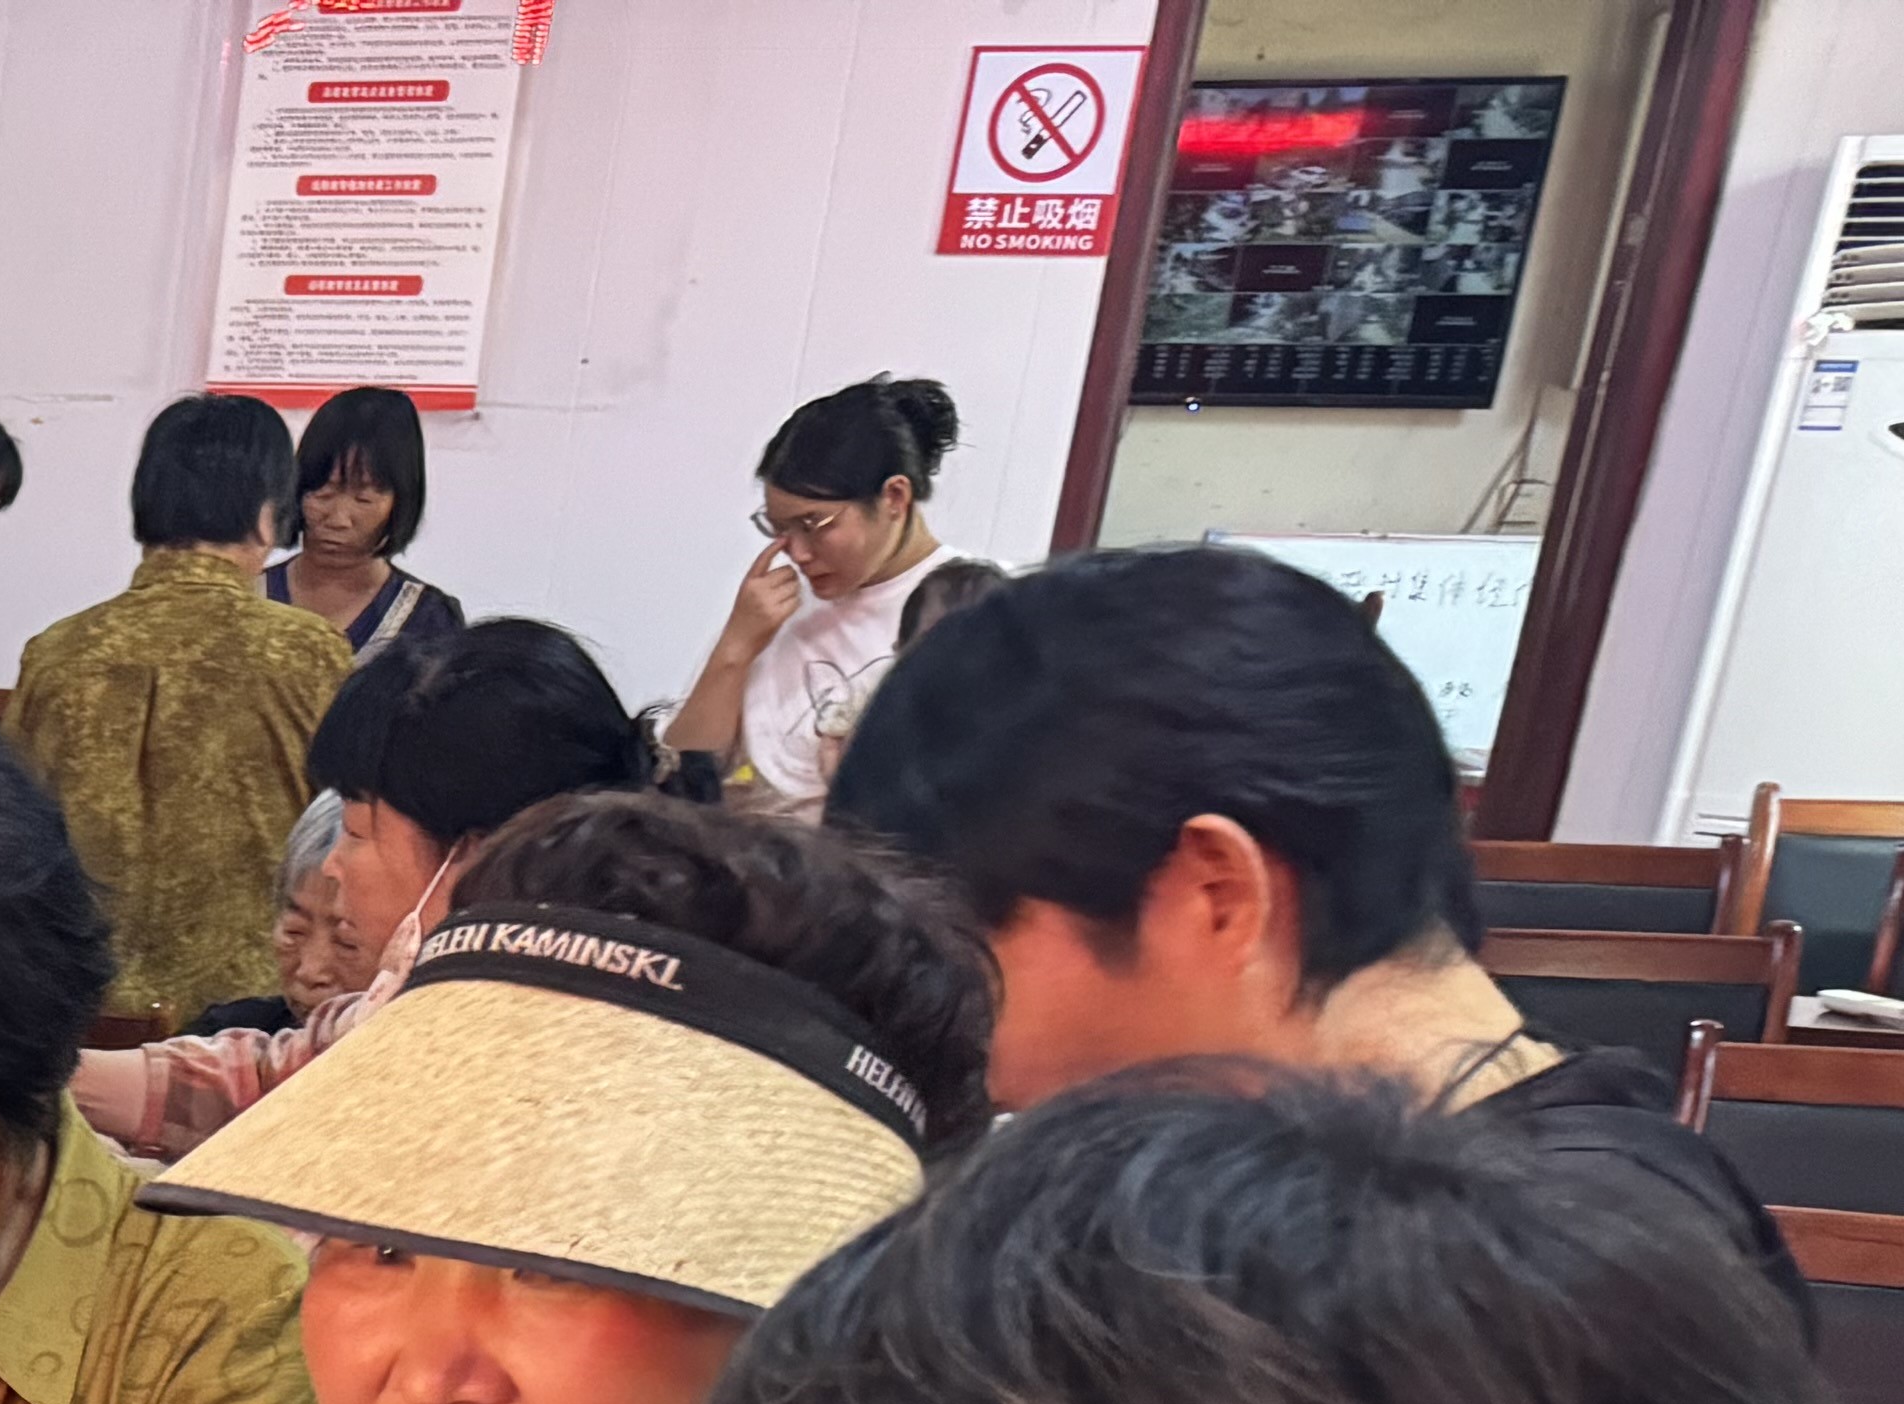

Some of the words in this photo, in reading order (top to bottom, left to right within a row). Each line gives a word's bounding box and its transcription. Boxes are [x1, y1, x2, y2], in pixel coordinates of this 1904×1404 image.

[962, 197, 1103, 230] 禁止吸烟
[960, 234, 992, 249] NO
[994, 234, 1094, 250] SMOKING
